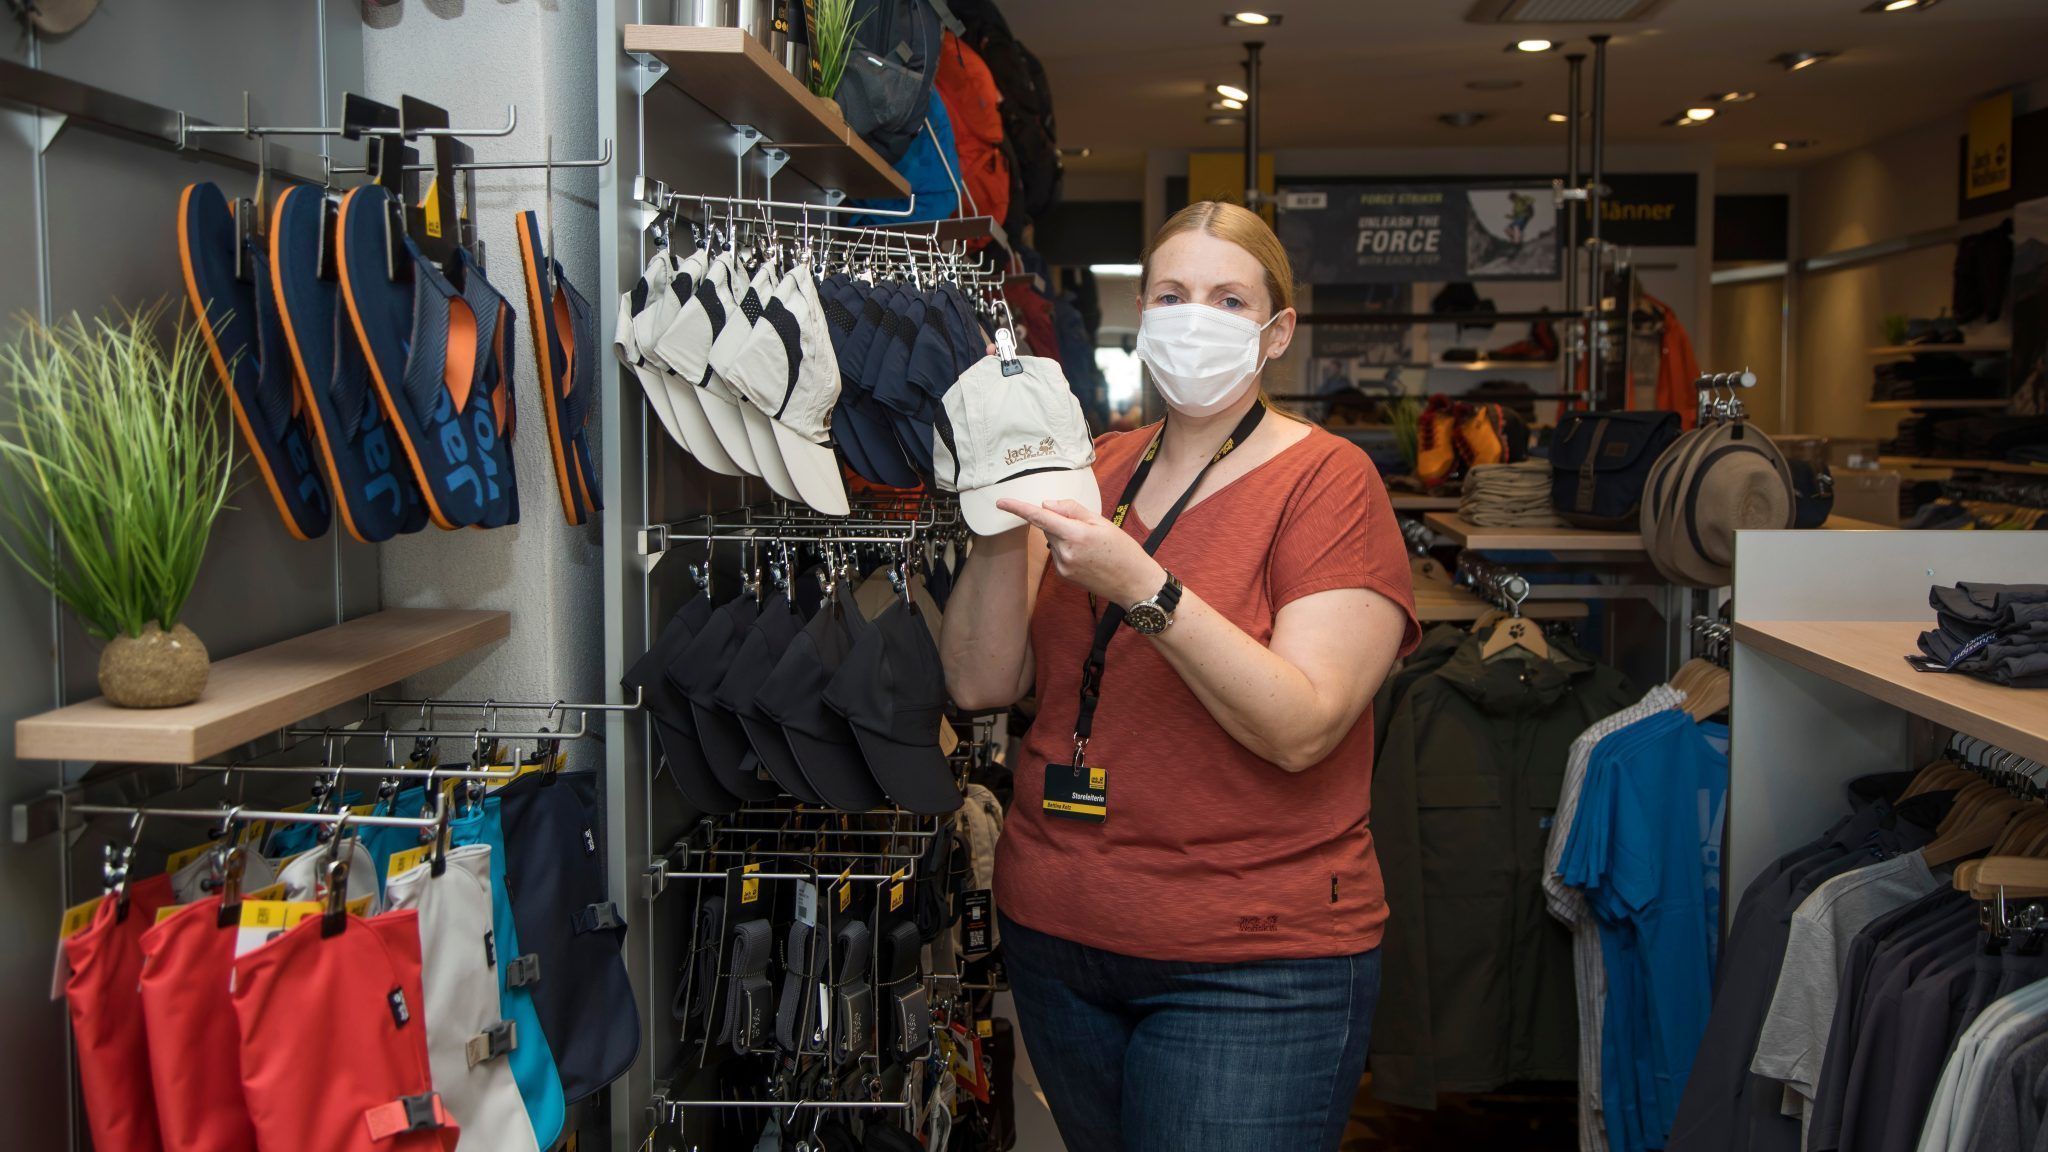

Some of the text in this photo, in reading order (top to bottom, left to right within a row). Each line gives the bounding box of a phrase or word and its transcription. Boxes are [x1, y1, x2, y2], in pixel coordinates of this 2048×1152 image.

[1358, 215, 1441, 229] UNLEASH THE
[1356, 229, 1441, 254] FORCE
[1004, 444, 1033, 461] Jack
[1071, 791, 1105, 803] Storeleiterin
